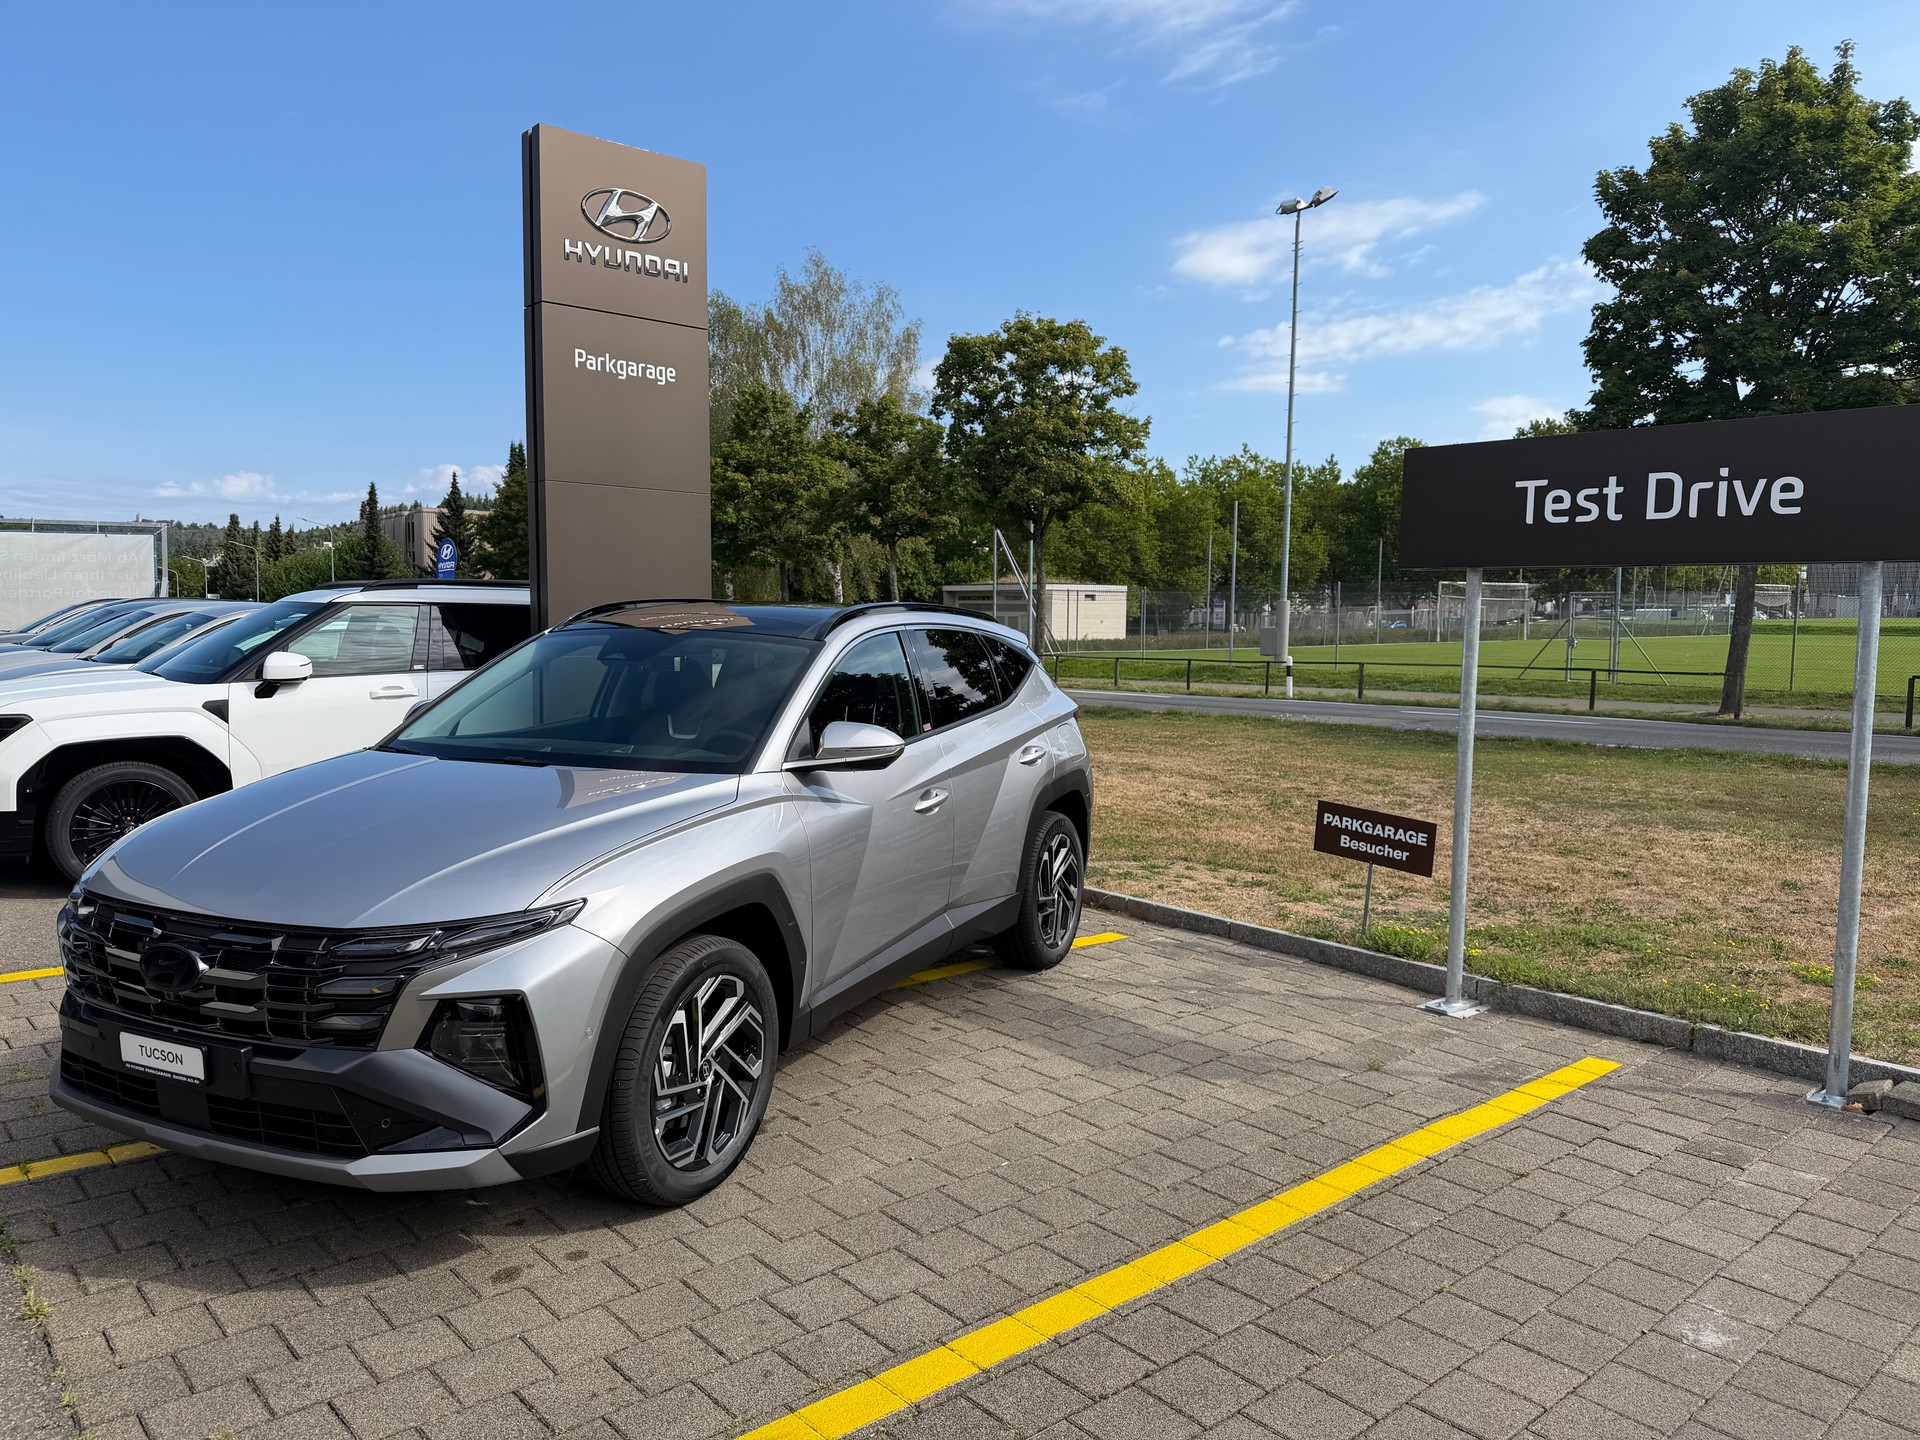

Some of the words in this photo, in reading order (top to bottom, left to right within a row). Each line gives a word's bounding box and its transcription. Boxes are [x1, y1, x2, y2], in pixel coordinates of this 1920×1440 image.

[563, 238, 689, 284] HYUNDAI
[574, 348, 677, 385] Parkgarage
[1515, 475, 1625, 525] Test
[1645, 466, 1805, 520] Drive
[1323, 812, 1428, 847] PARKGARAGE
[1339, 834, 1410, 861] Besucher
[138, 1044, 184, 1066] TUCSON
